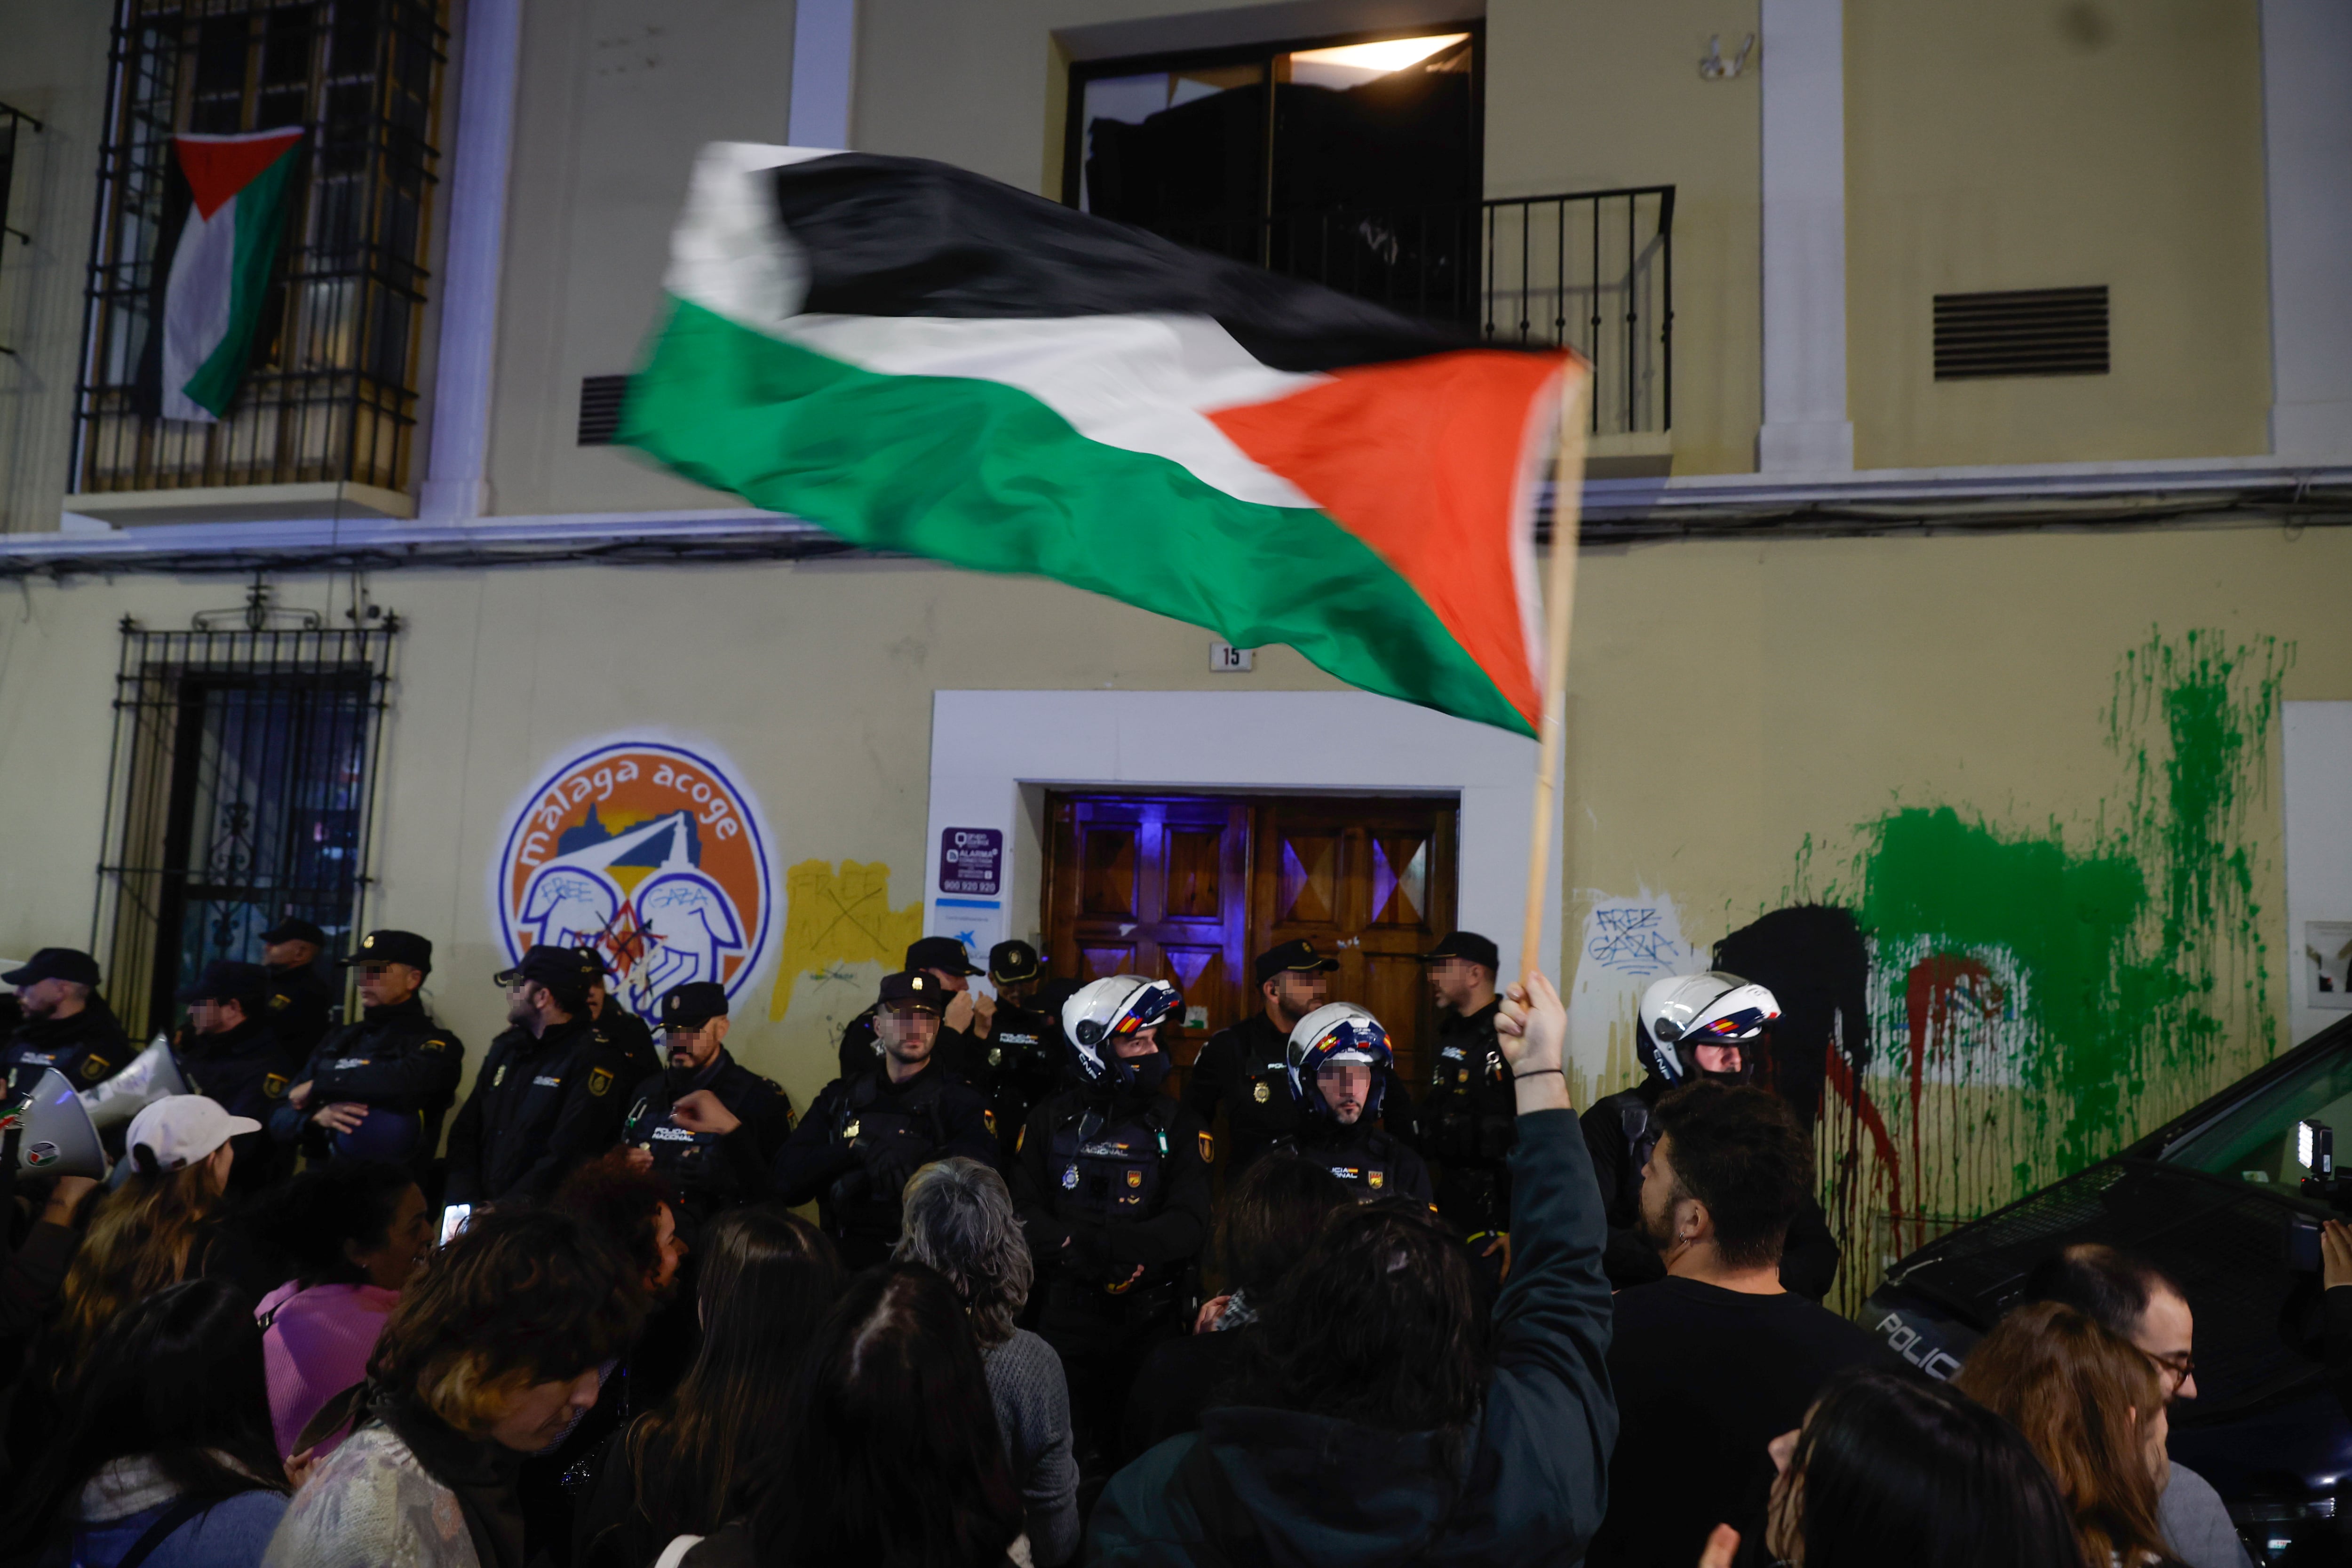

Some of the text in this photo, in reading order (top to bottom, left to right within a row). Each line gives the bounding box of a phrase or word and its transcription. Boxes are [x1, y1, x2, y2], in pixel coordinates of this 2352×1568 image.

[1223, 647, 1240, 665] 15
[652, 764, 738, 840] acoge
[960, 849, 993, 858] ALARMA
[541, 877, 708, 908] FREE GAZA
[1597, 908, 1662, 931] FREE
[1589, 931, 1679, 961] GAZA
[1875, 1312, 1963, 1382] POLIC
